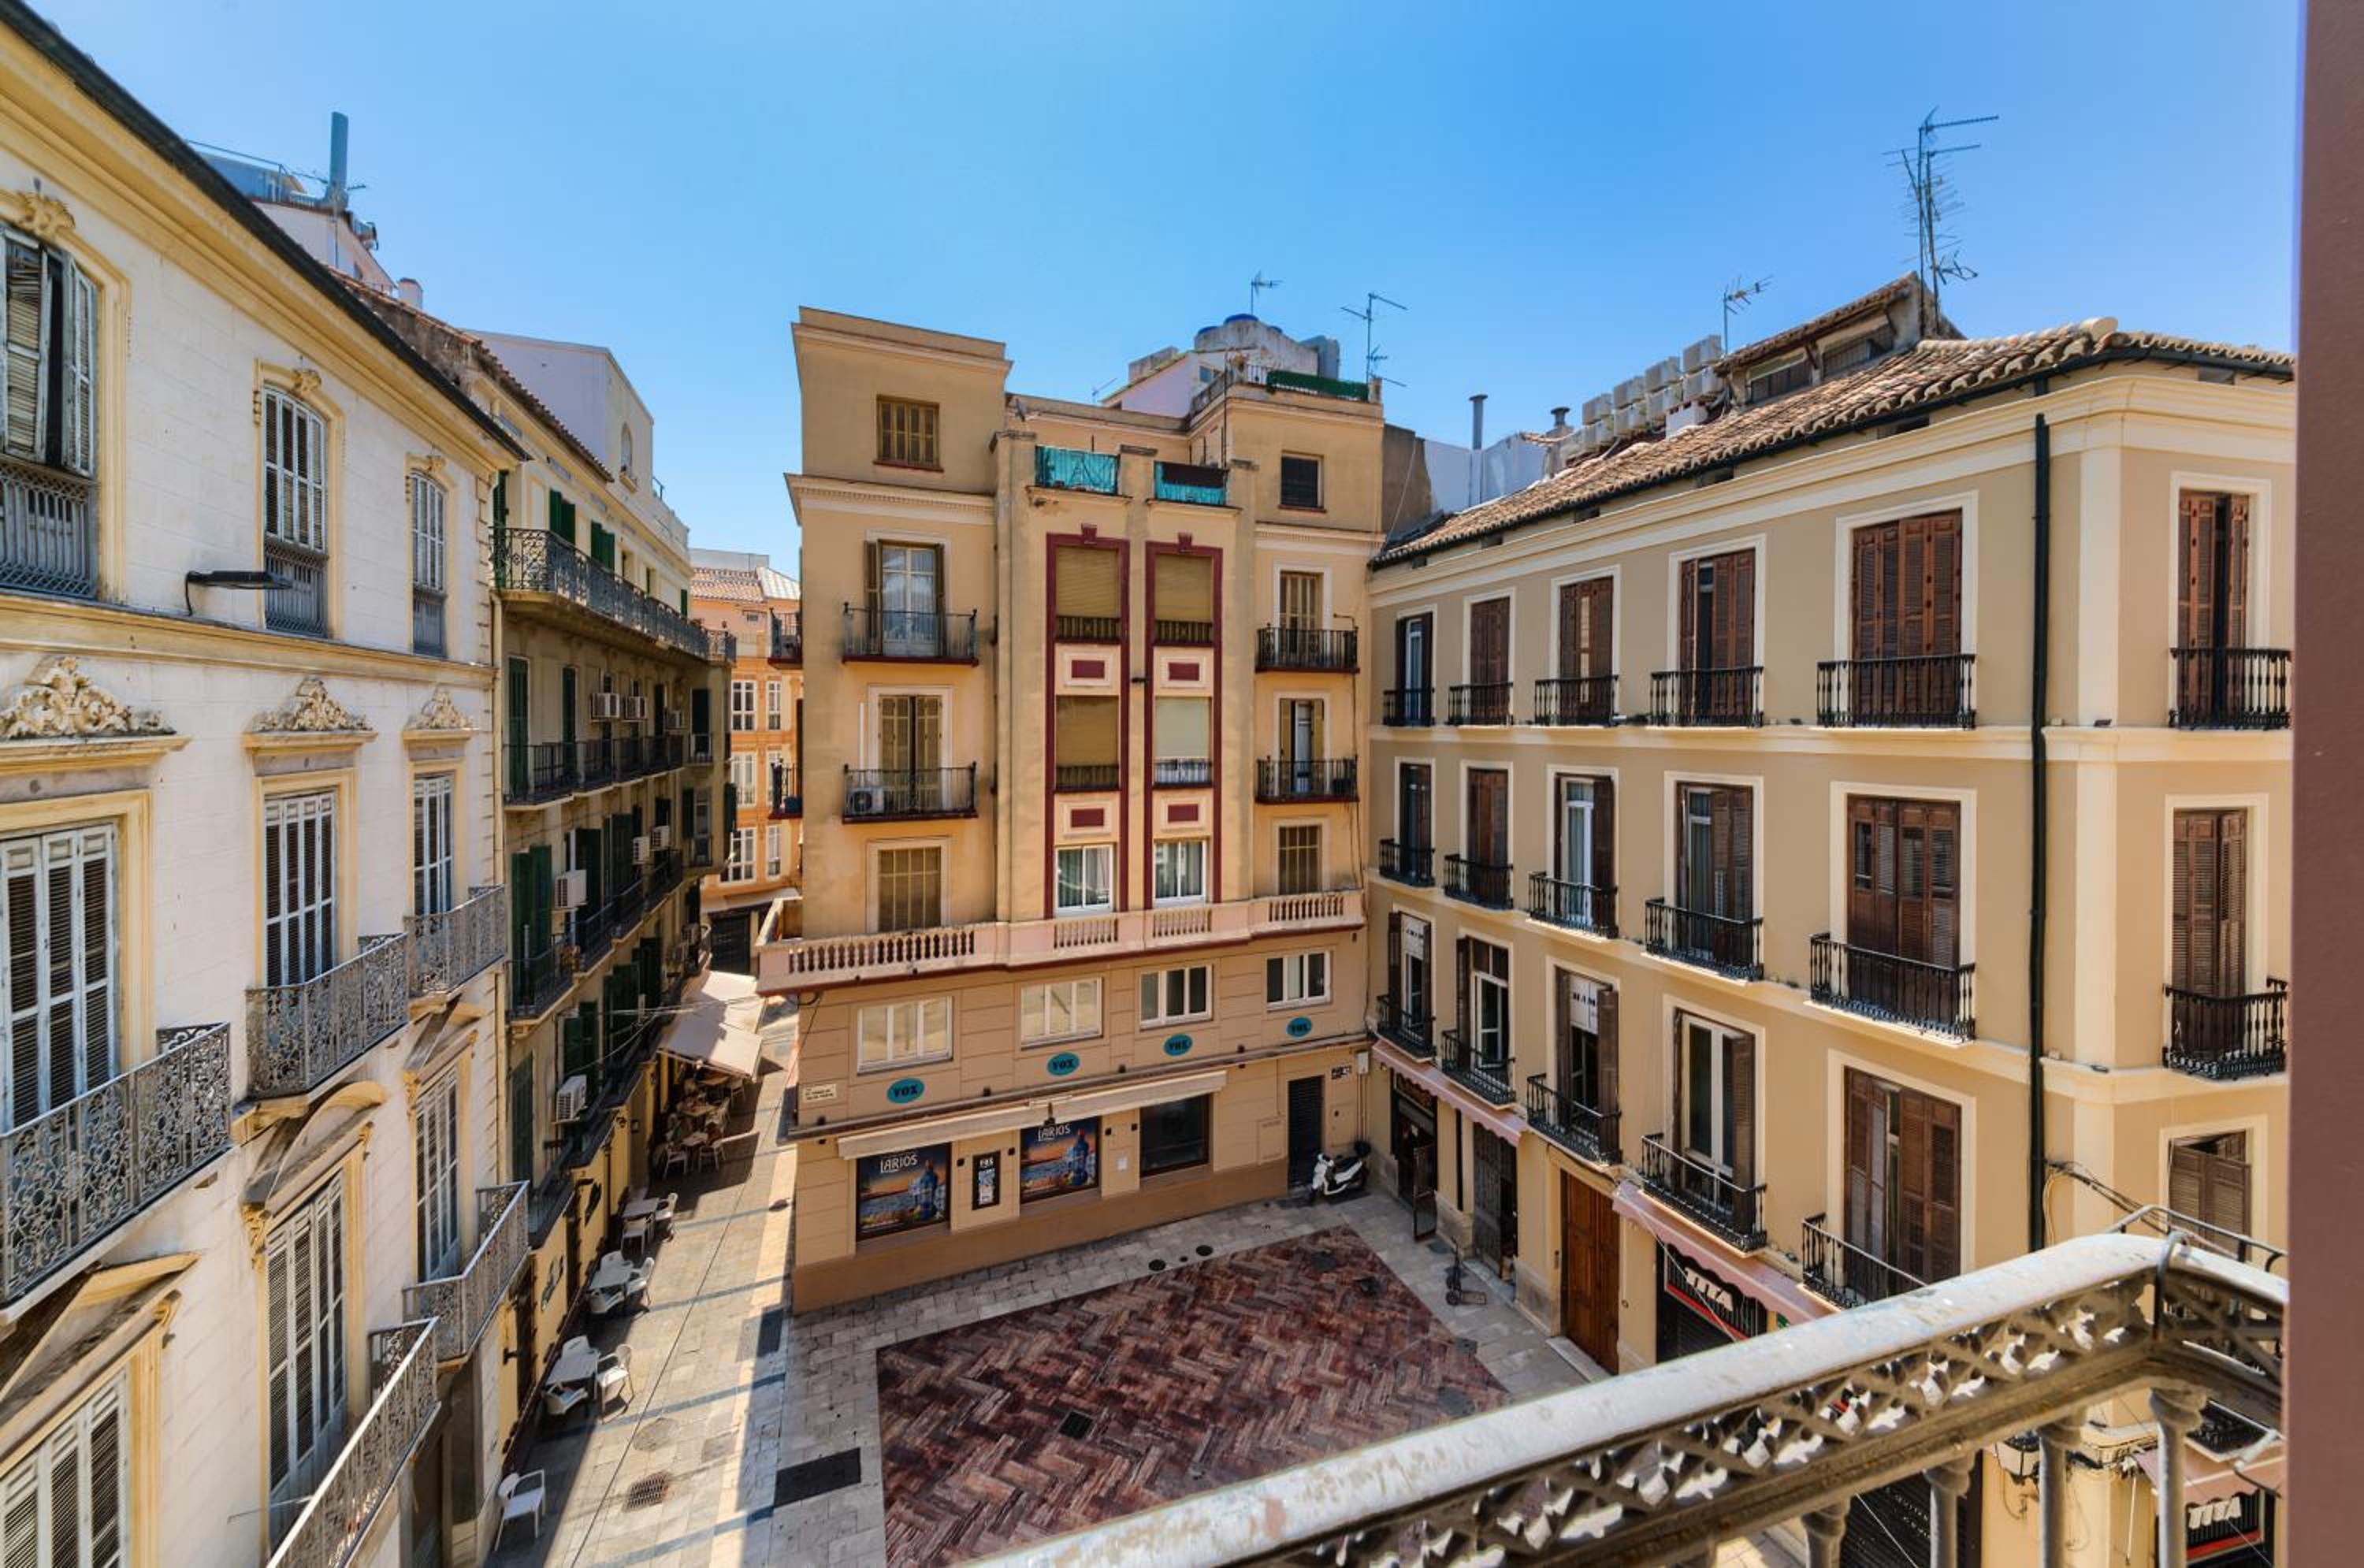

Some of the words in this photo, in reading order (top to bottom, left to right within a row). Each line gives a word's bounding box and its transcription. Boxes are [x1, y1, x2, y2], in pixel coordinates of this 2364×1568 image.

[893, 1083, 918, 1098] VOX
[1038, 1124, 1072, 1142] LARIOS
[880, 1154, 919, 1174] LARIOS
